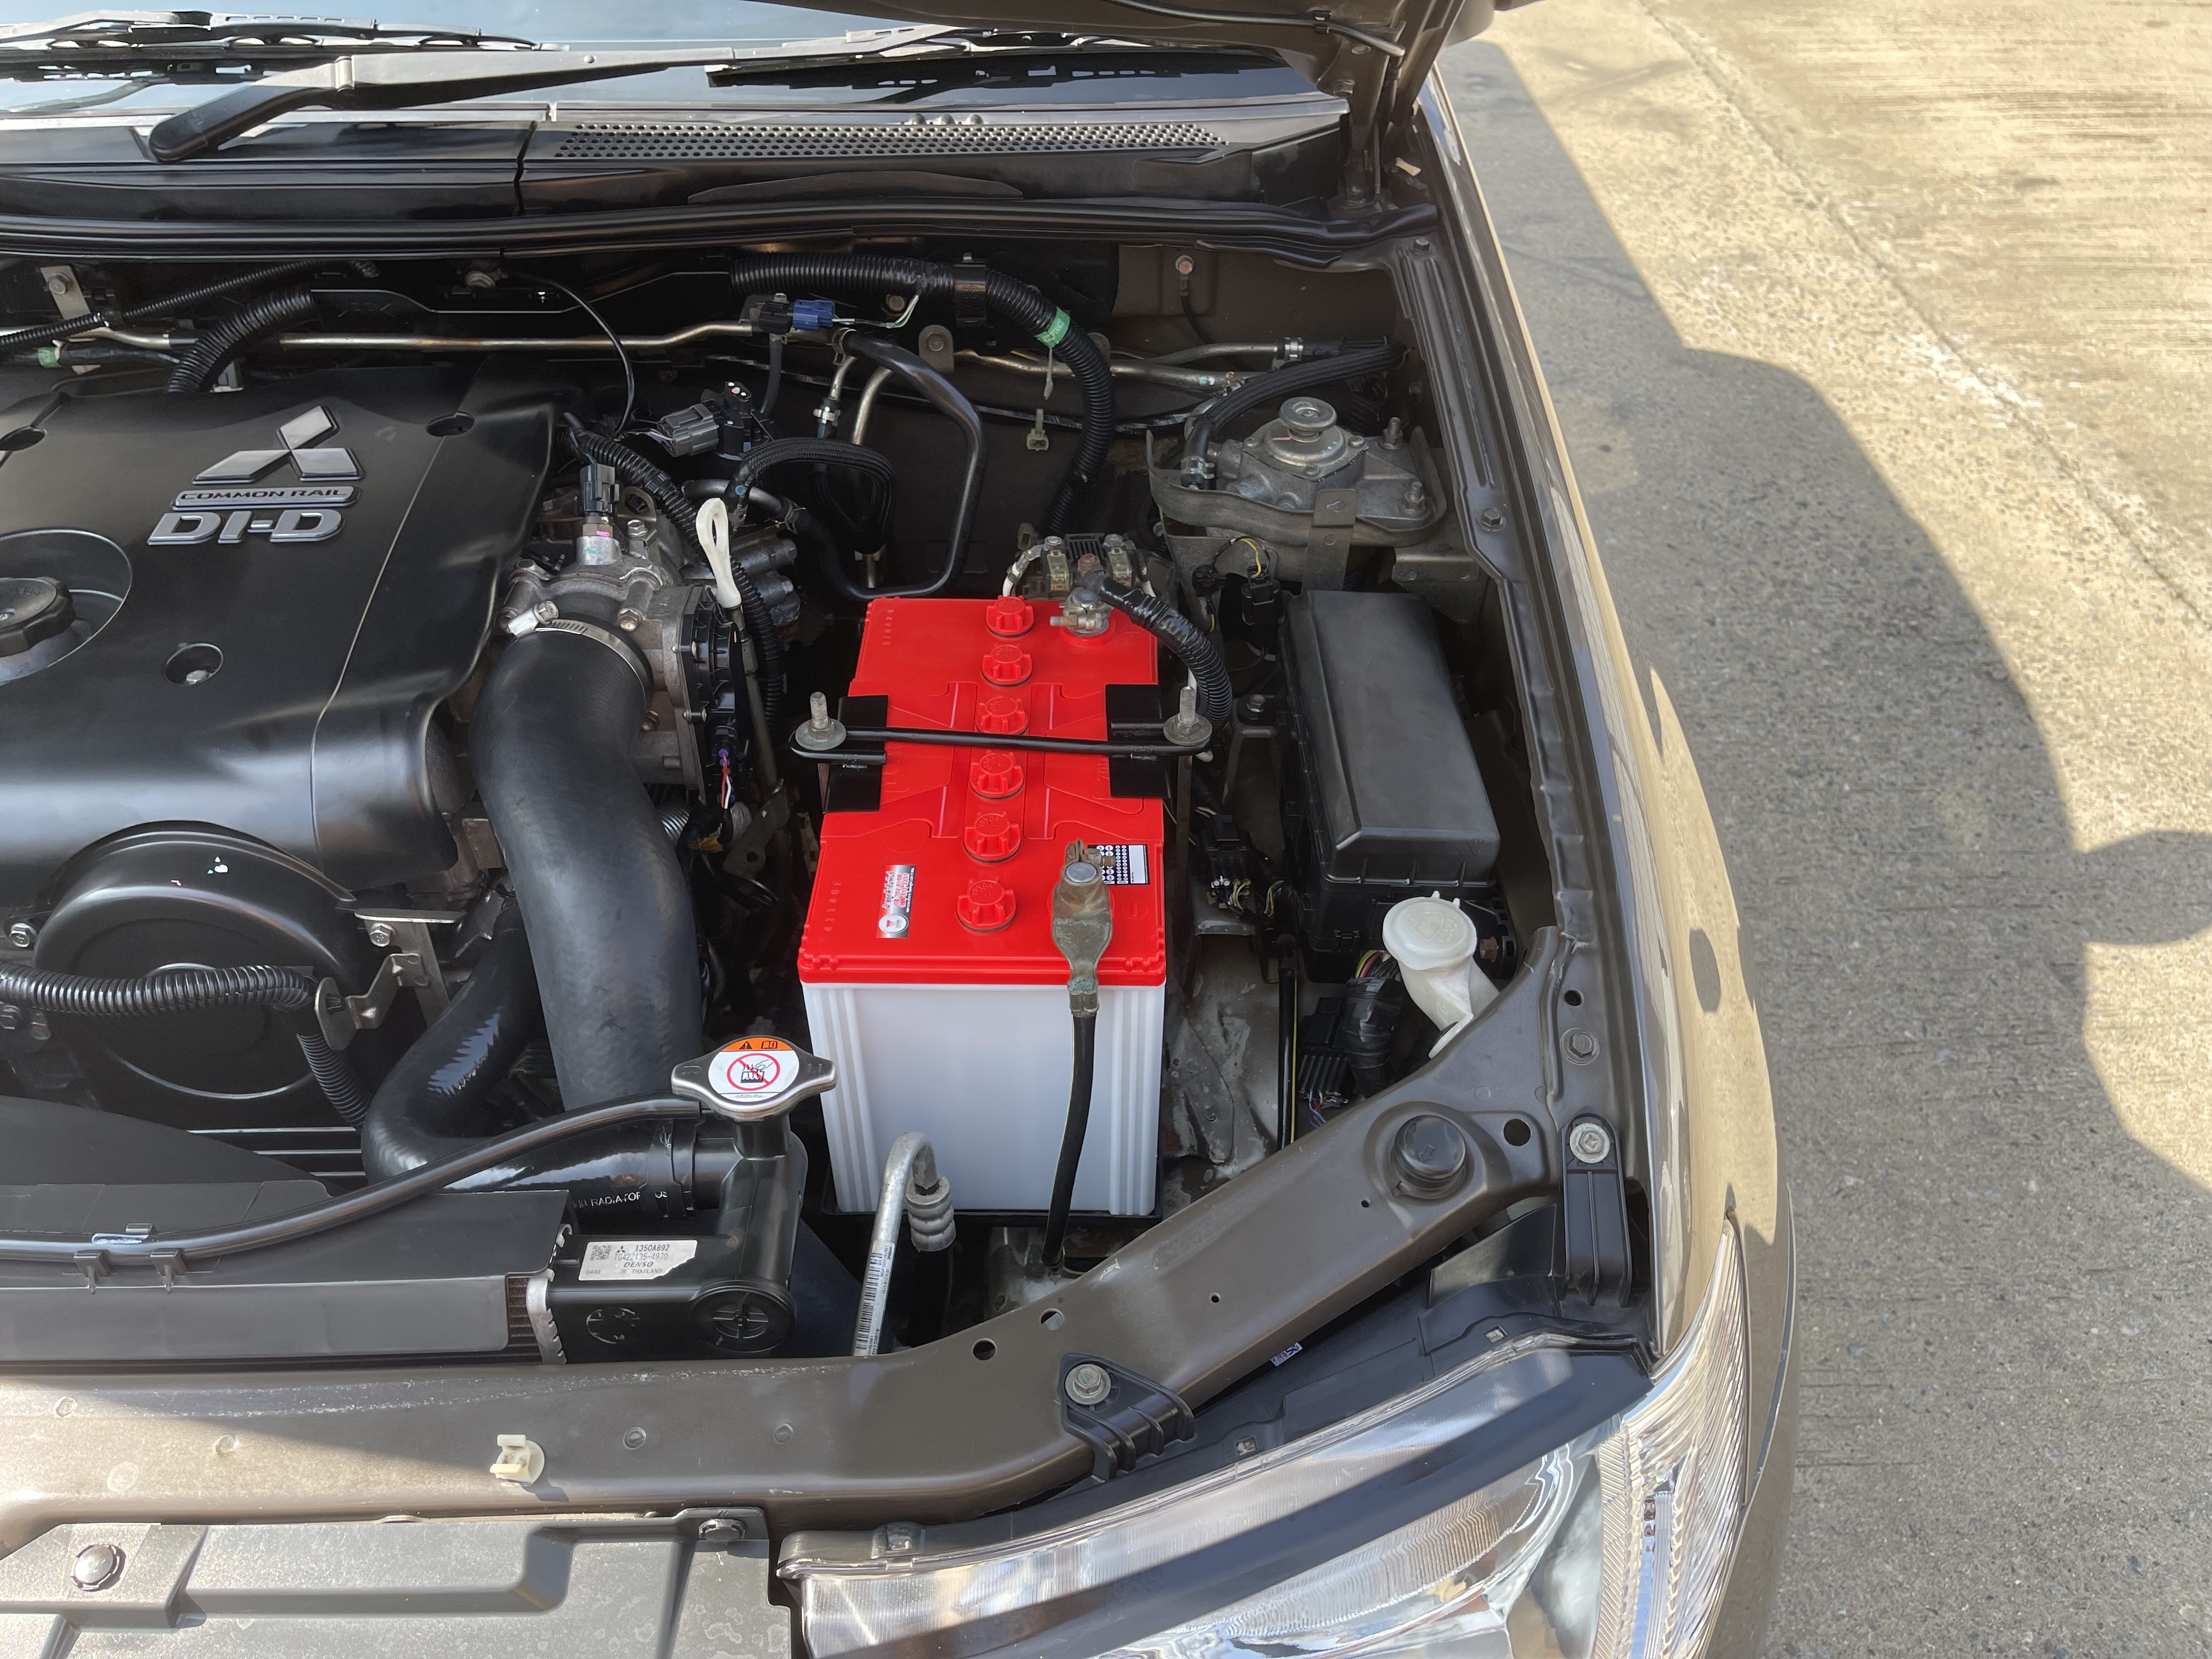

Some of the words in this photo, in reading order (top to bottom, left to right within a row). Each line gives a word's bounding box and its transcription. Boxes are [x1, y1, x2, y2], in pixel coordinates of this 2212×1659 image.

[180, 490, 285, 500] COMMON
[290, 487, 348, 497] RAIL
[147, 509, 345, 545] DI-D
[614, 1252, 668, 1261] TG422135-4970
